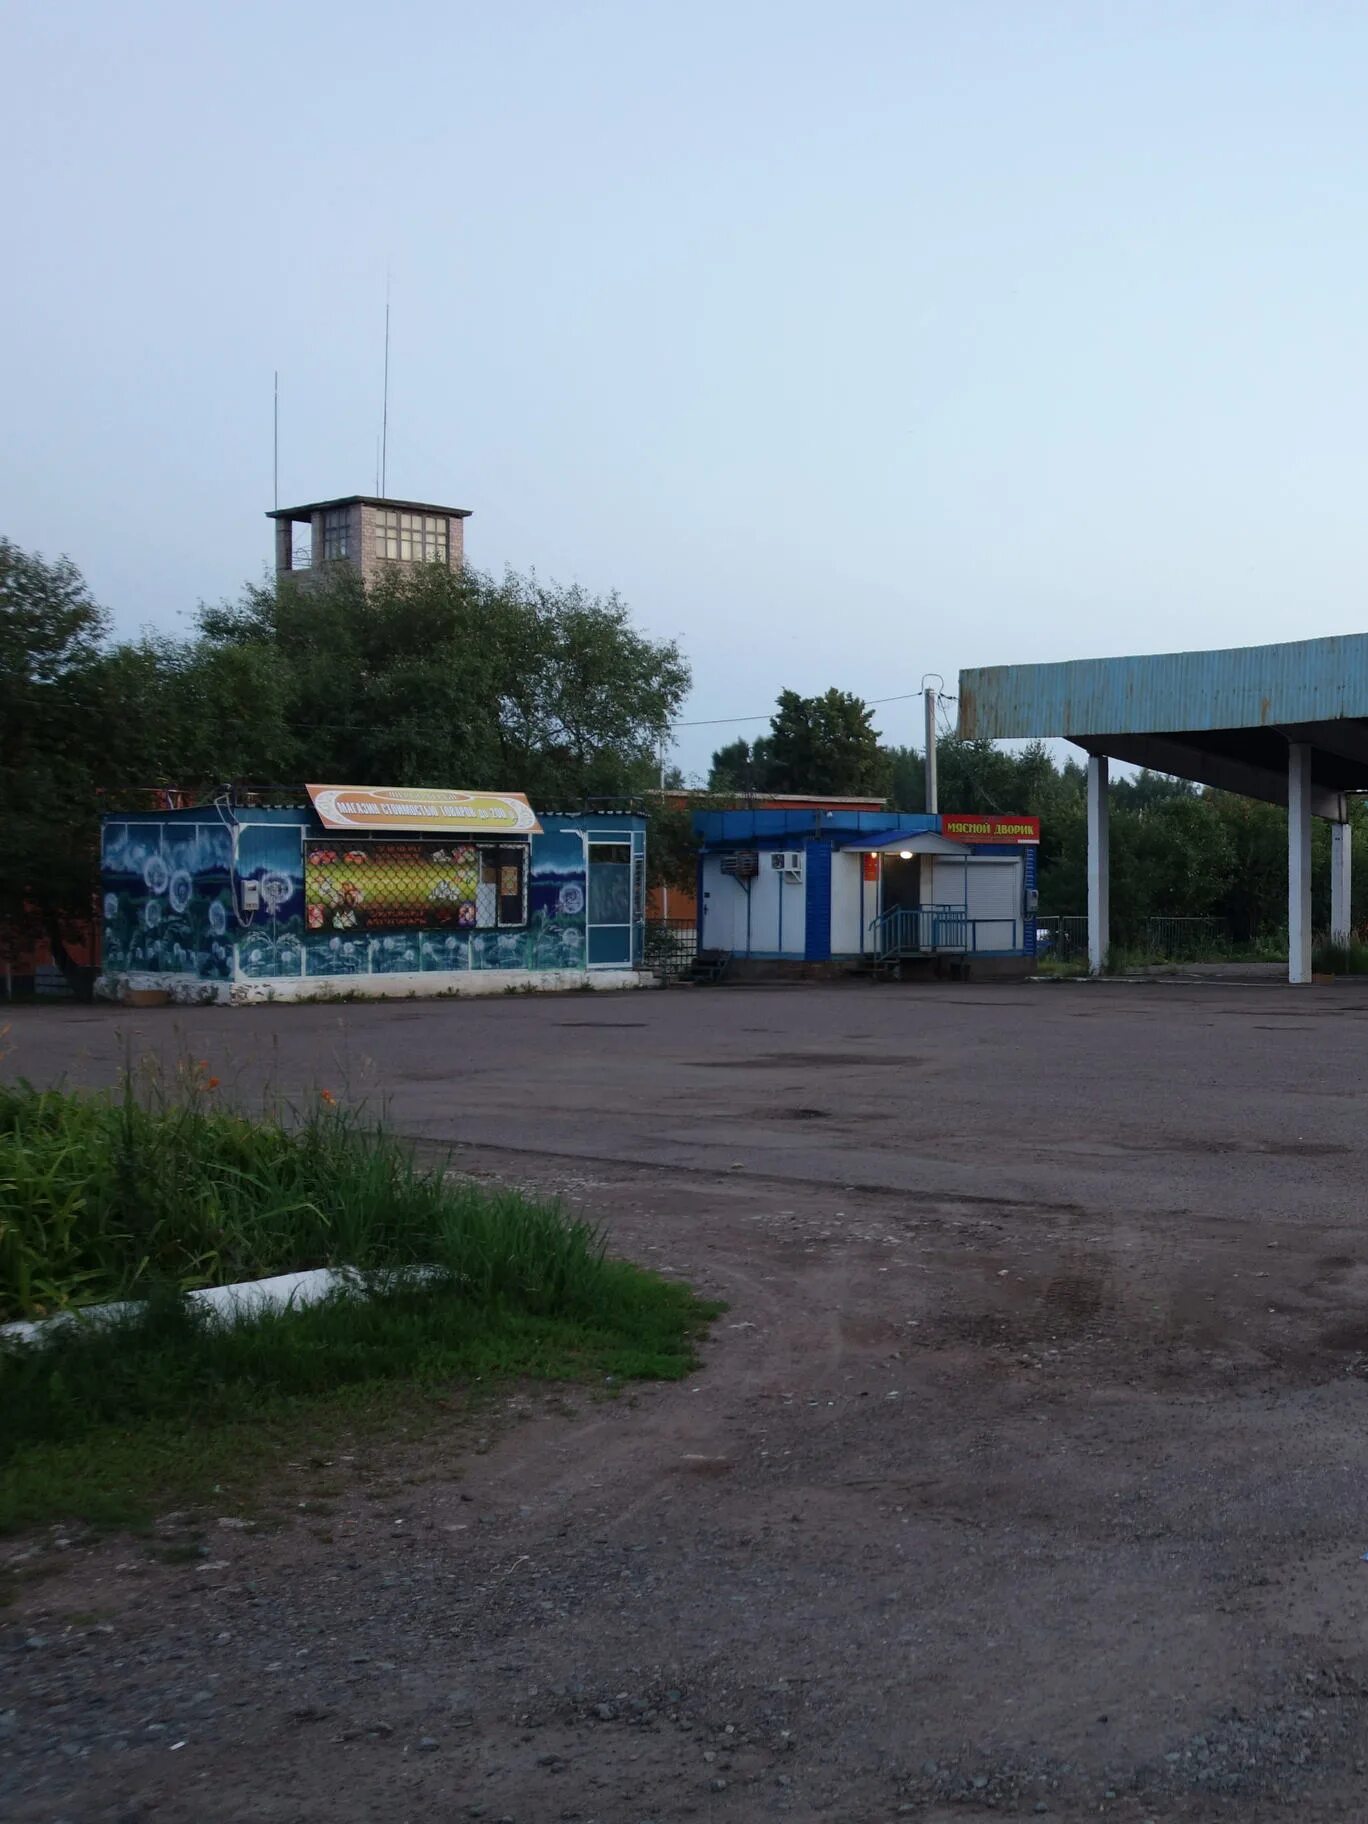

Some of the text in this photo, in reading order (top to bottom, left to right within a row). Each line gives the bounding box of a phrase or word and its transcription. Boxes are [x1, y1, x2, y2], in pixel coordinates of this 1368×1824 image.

[336, 801, 381, 815] МАГАЗИН
[381, 803, 438, 817] СТОИМОСТЬЮ
[440, 805, 477, 818] ТОВАРОВ
[947, 822, 1034, 836] МЯСНОЙ ДВОРИК
